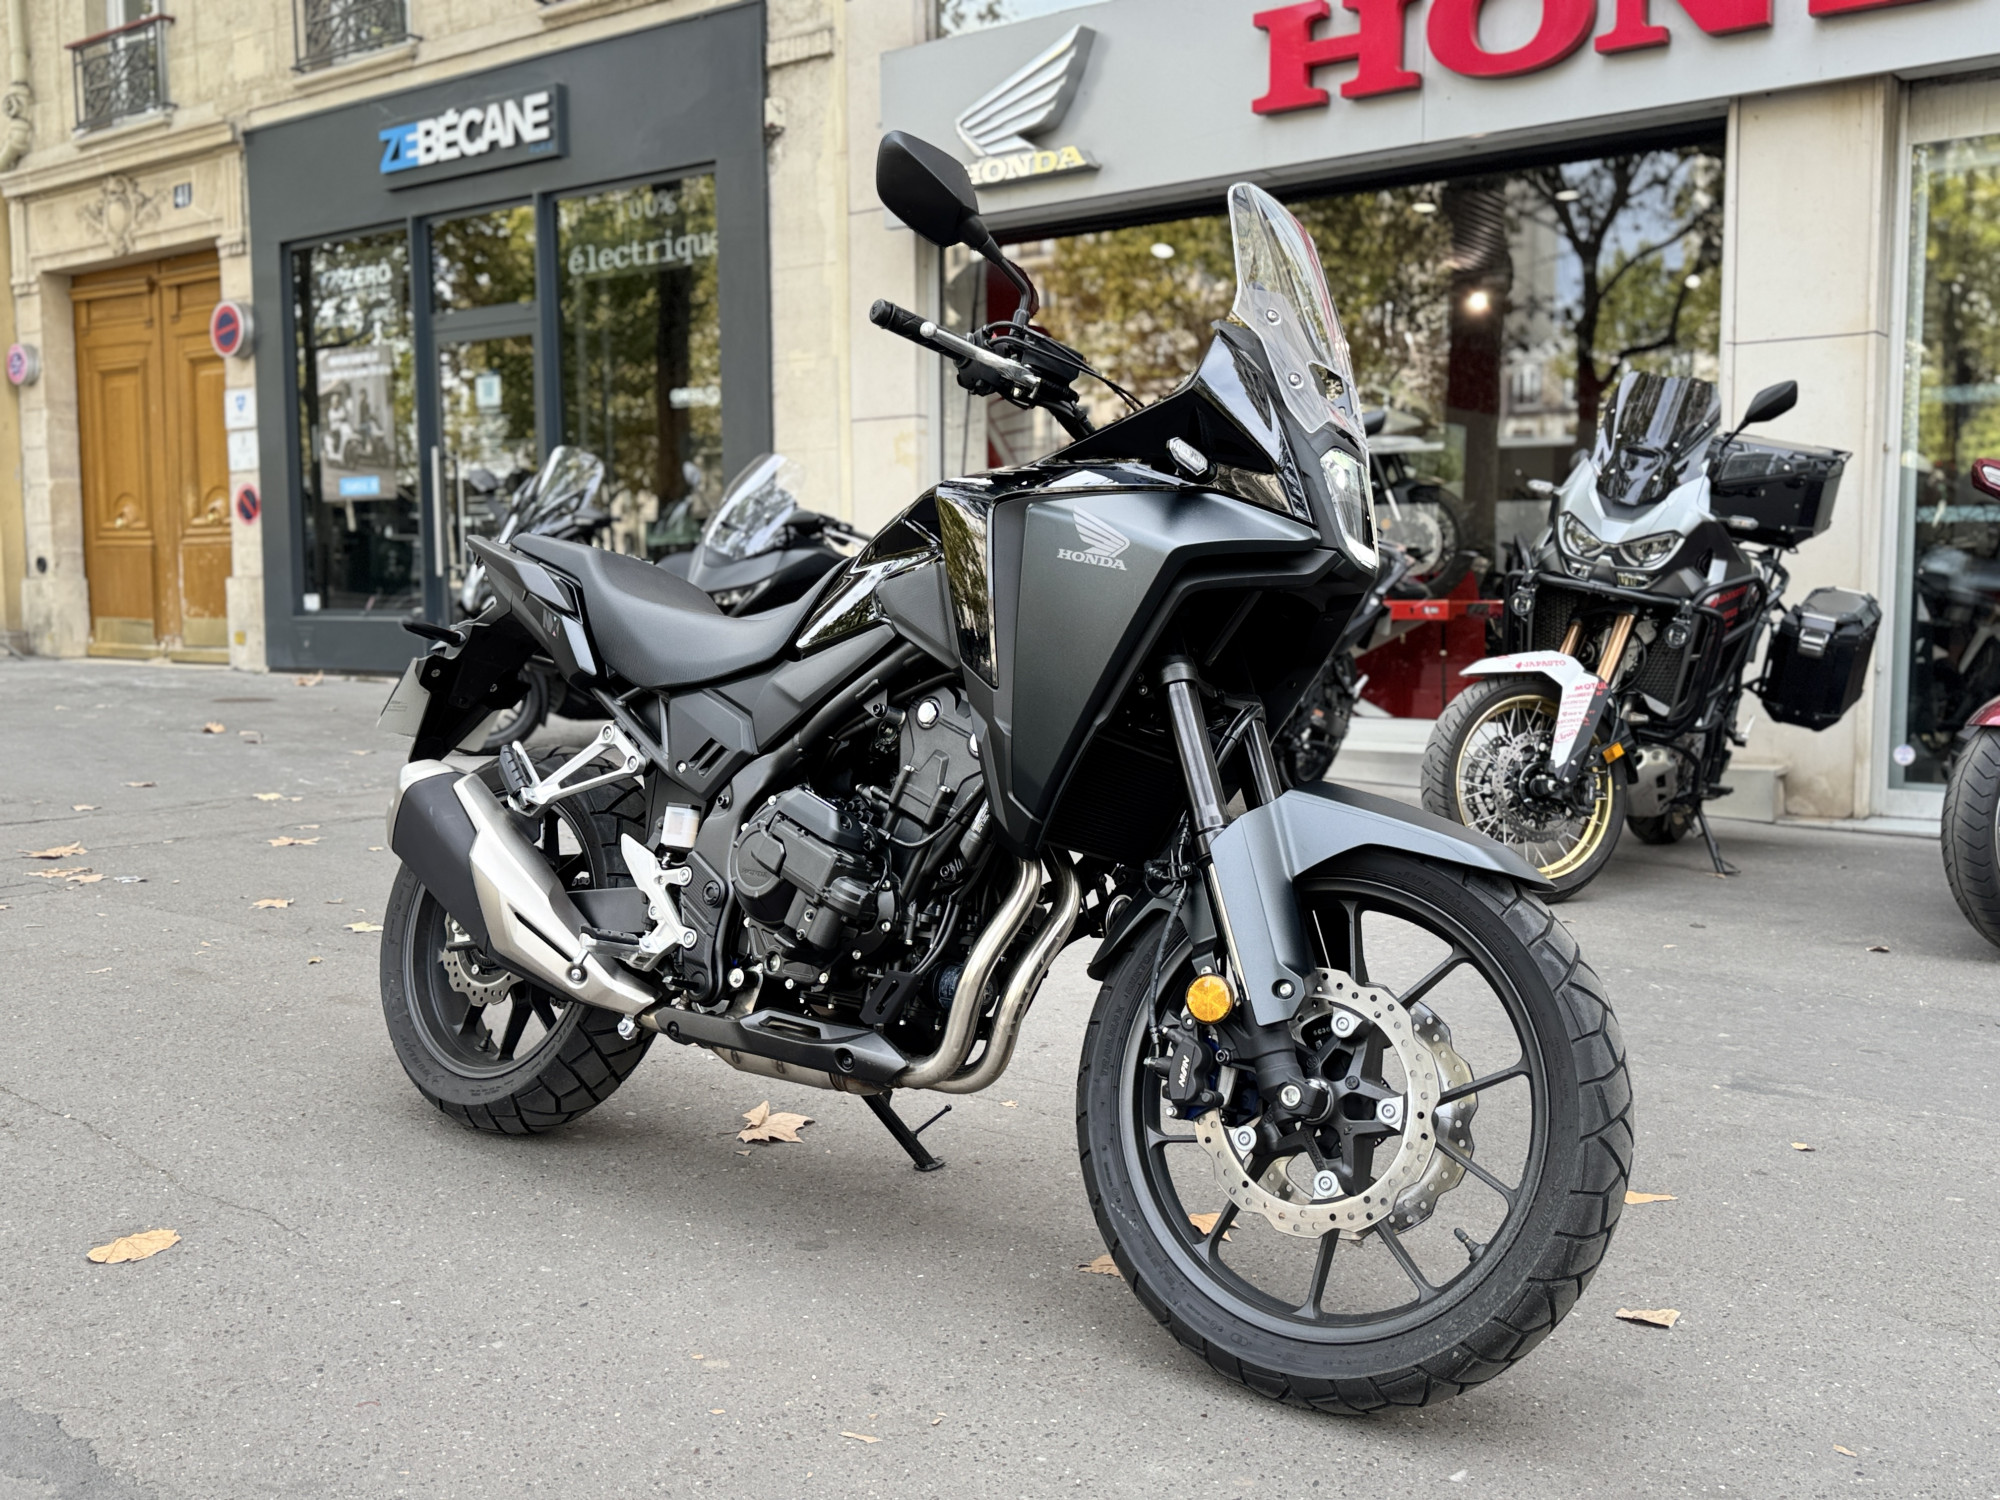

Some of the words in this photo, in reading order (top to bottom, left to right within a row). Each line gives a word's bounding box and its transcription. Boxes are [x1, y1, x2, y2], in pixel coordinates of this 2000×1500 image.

[378, 91, 550, 174] ZEBÉCANE
[1056, 548, 1128, 571] HONDA
[1574, 681, 1609, 691] MOTUL
